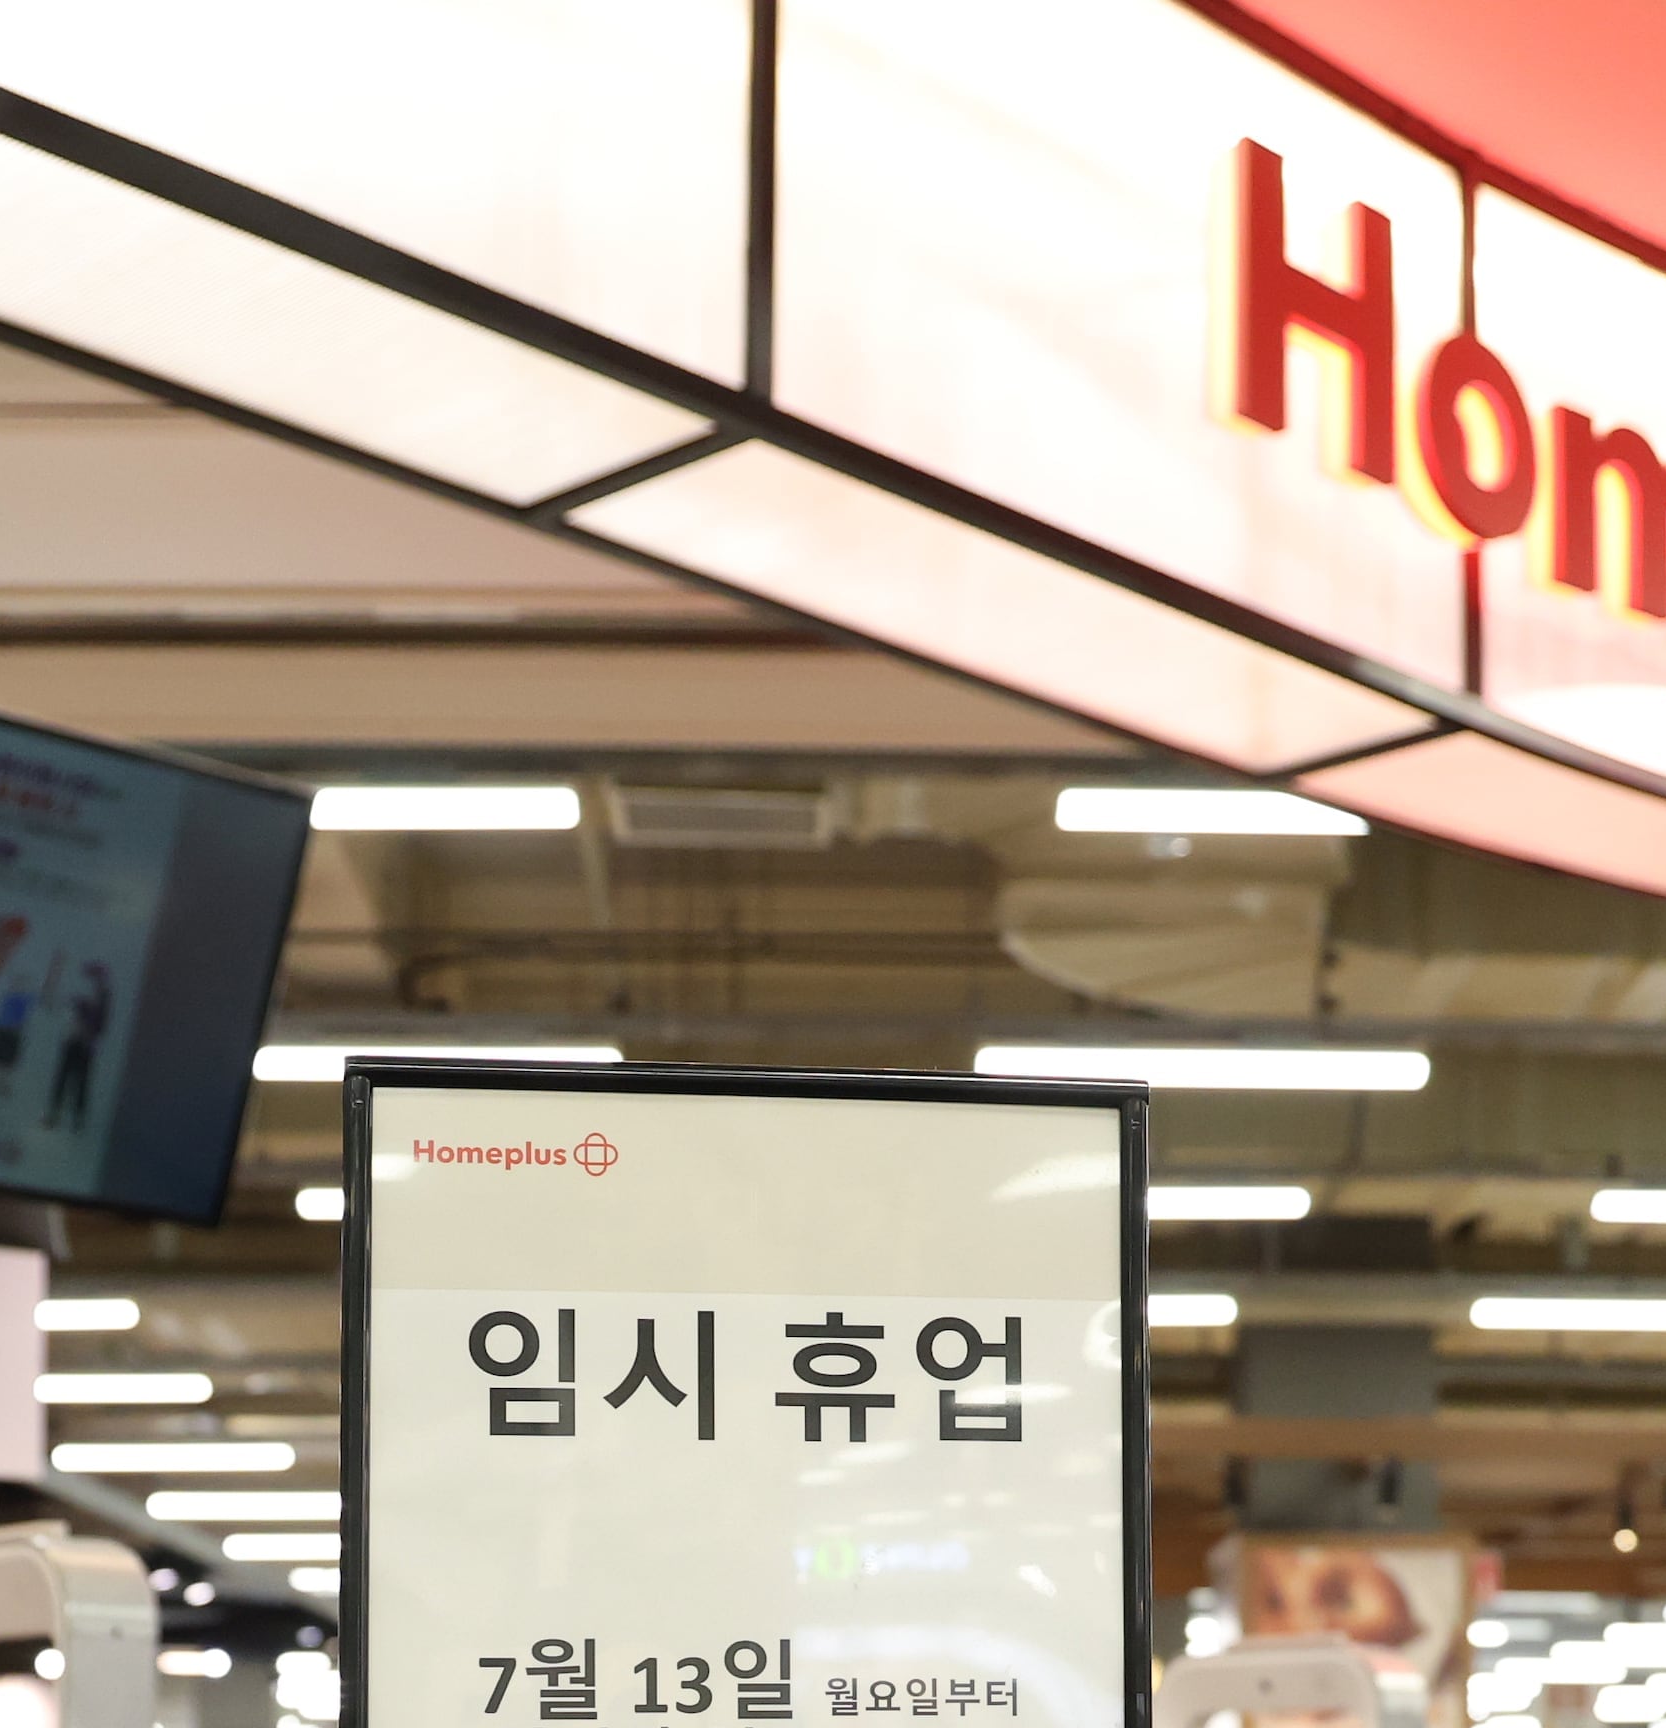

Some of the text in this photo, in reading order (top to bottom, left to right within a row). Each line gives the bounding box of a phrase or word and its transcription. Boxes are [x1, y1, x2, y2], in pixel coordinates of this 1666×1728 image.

[412, 1139, 567, 1171] Homeplus
[468, 1308, 1023, 1443] 임시 휴업
[478, 1637, 1019, 1721] 7월 13일 월요일부터
